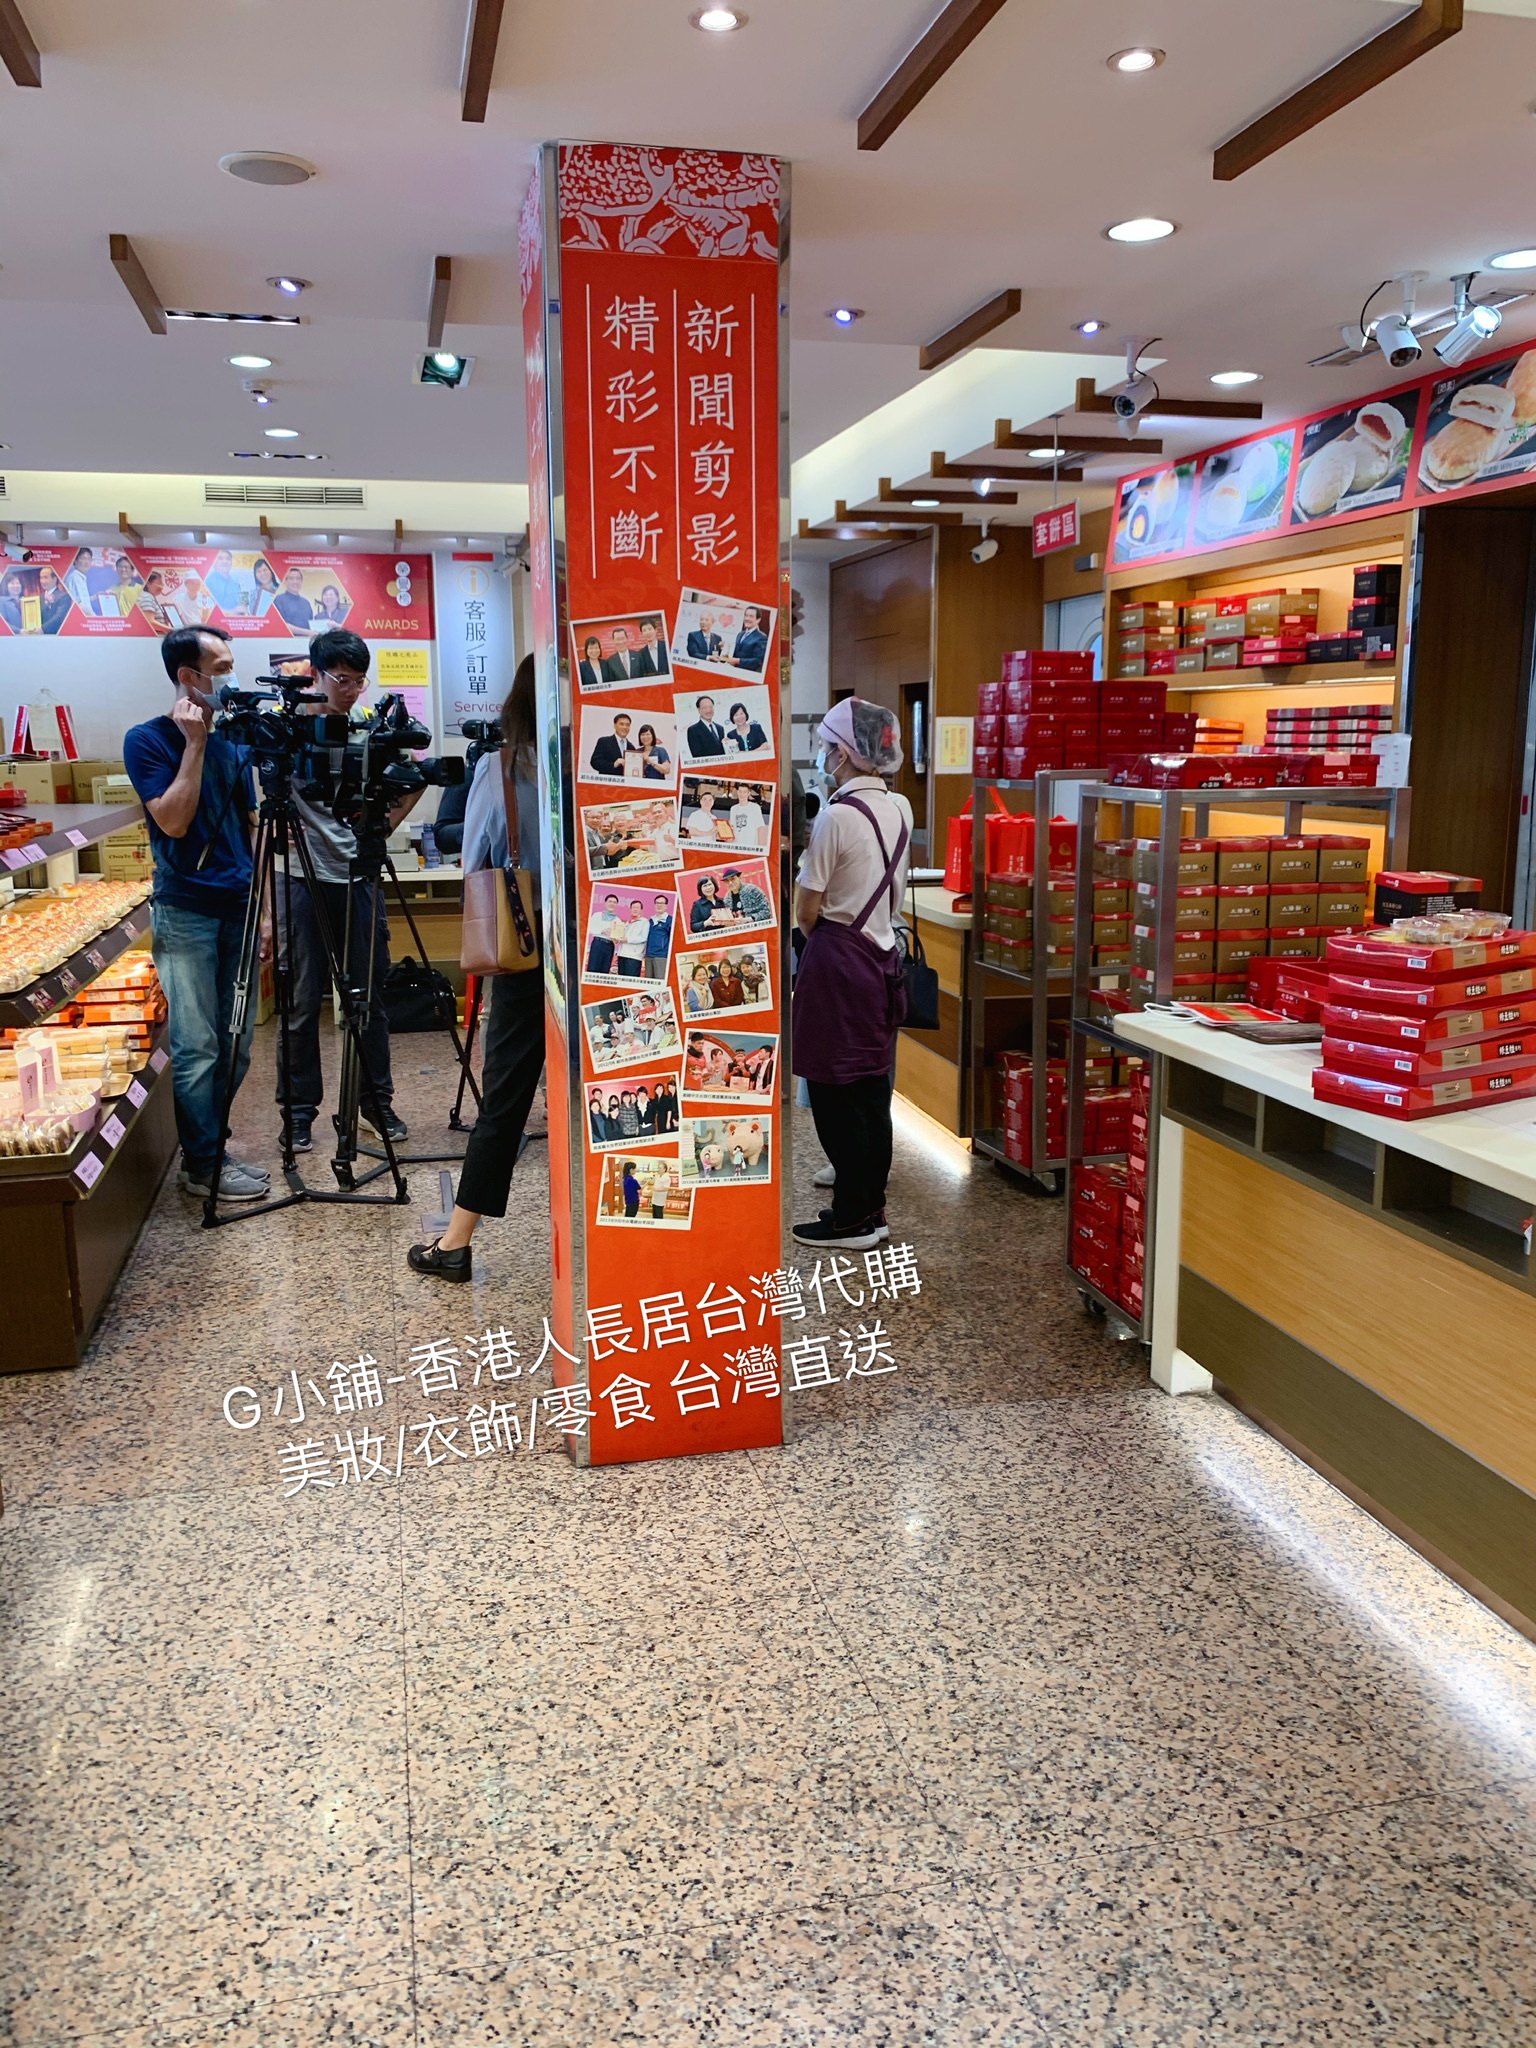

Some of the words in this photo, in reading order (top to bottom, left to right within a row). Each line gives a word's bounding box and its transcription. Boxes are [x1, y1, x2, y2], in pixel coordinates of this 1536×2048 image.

[602, 295, 664, 566] 精彩不斷
[684, 299, 740, 566] 新聞剪影
[1035, 510, 1075, 548] 套餅區
[365, 619, 419, 631] AWARDS
[454, 700, 503, 713] Service
